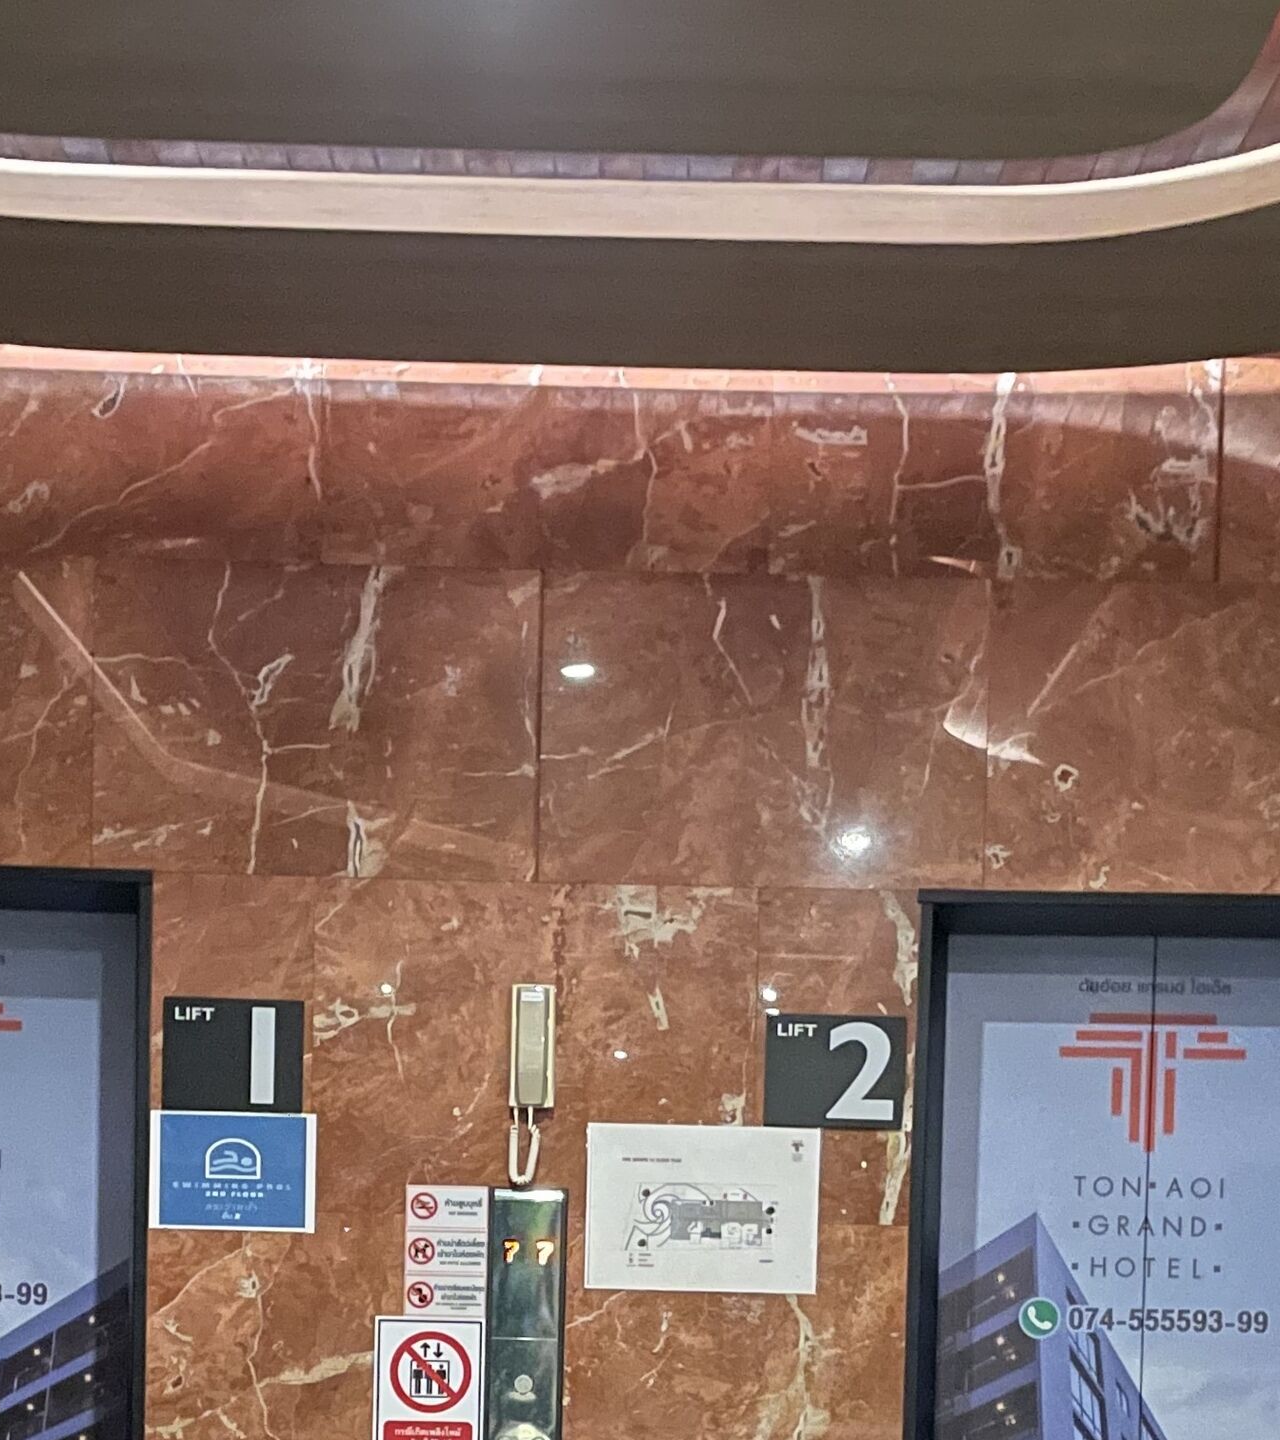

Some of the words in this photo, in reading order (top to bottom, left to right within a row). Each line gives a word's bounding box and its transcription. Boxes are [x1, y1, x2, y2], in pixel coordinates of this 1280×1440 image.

[174, 1006, 215, 1021] LIFT
[250, 1006, 276, 1104] 1
[777, 1023, 817, 1037] LIFT
[825, 1021, 894, 1121] 2
[1068, 1307, 1269, 1335] 074-555593-99
